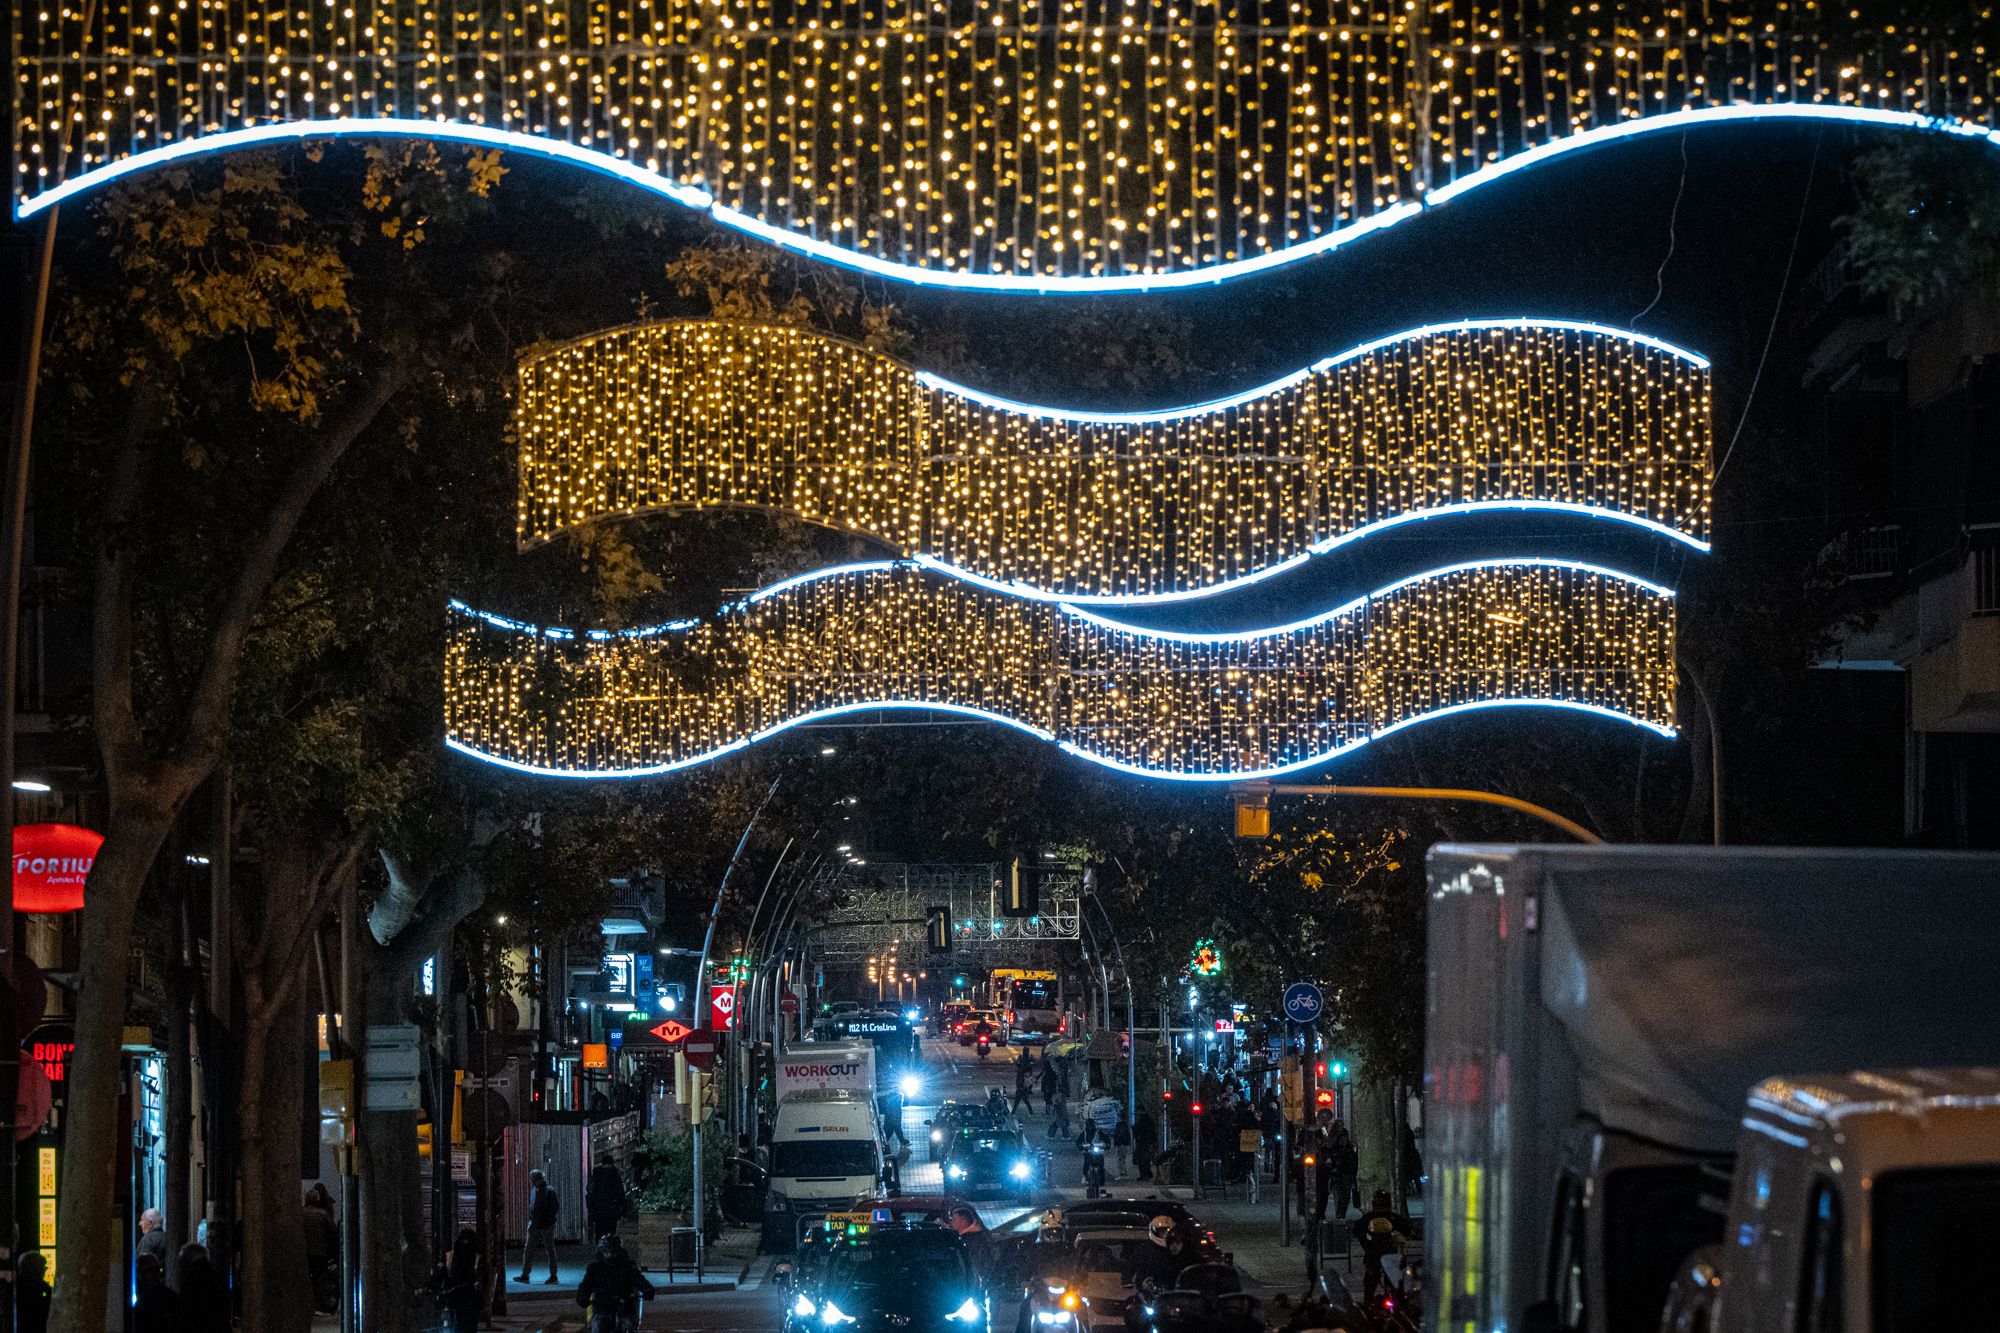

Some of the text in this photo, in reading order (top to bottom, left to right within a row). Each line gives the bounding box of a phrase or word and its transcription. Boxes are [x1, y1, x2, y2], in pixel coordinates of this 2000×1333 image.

[14, 857, 92, 875] PORTIU
[720, 998, 732, 1007] M
[662, 1026, 680, 1036] M
[870, 1022, 897, 1032] Cristina
[785, 1064, 859, 1077] WORKOUT
[877, 1211, 886, 1221] L
[832, 1221, 845, 1230] TAXI
[856, 1224, 870, 1234] TAXI
